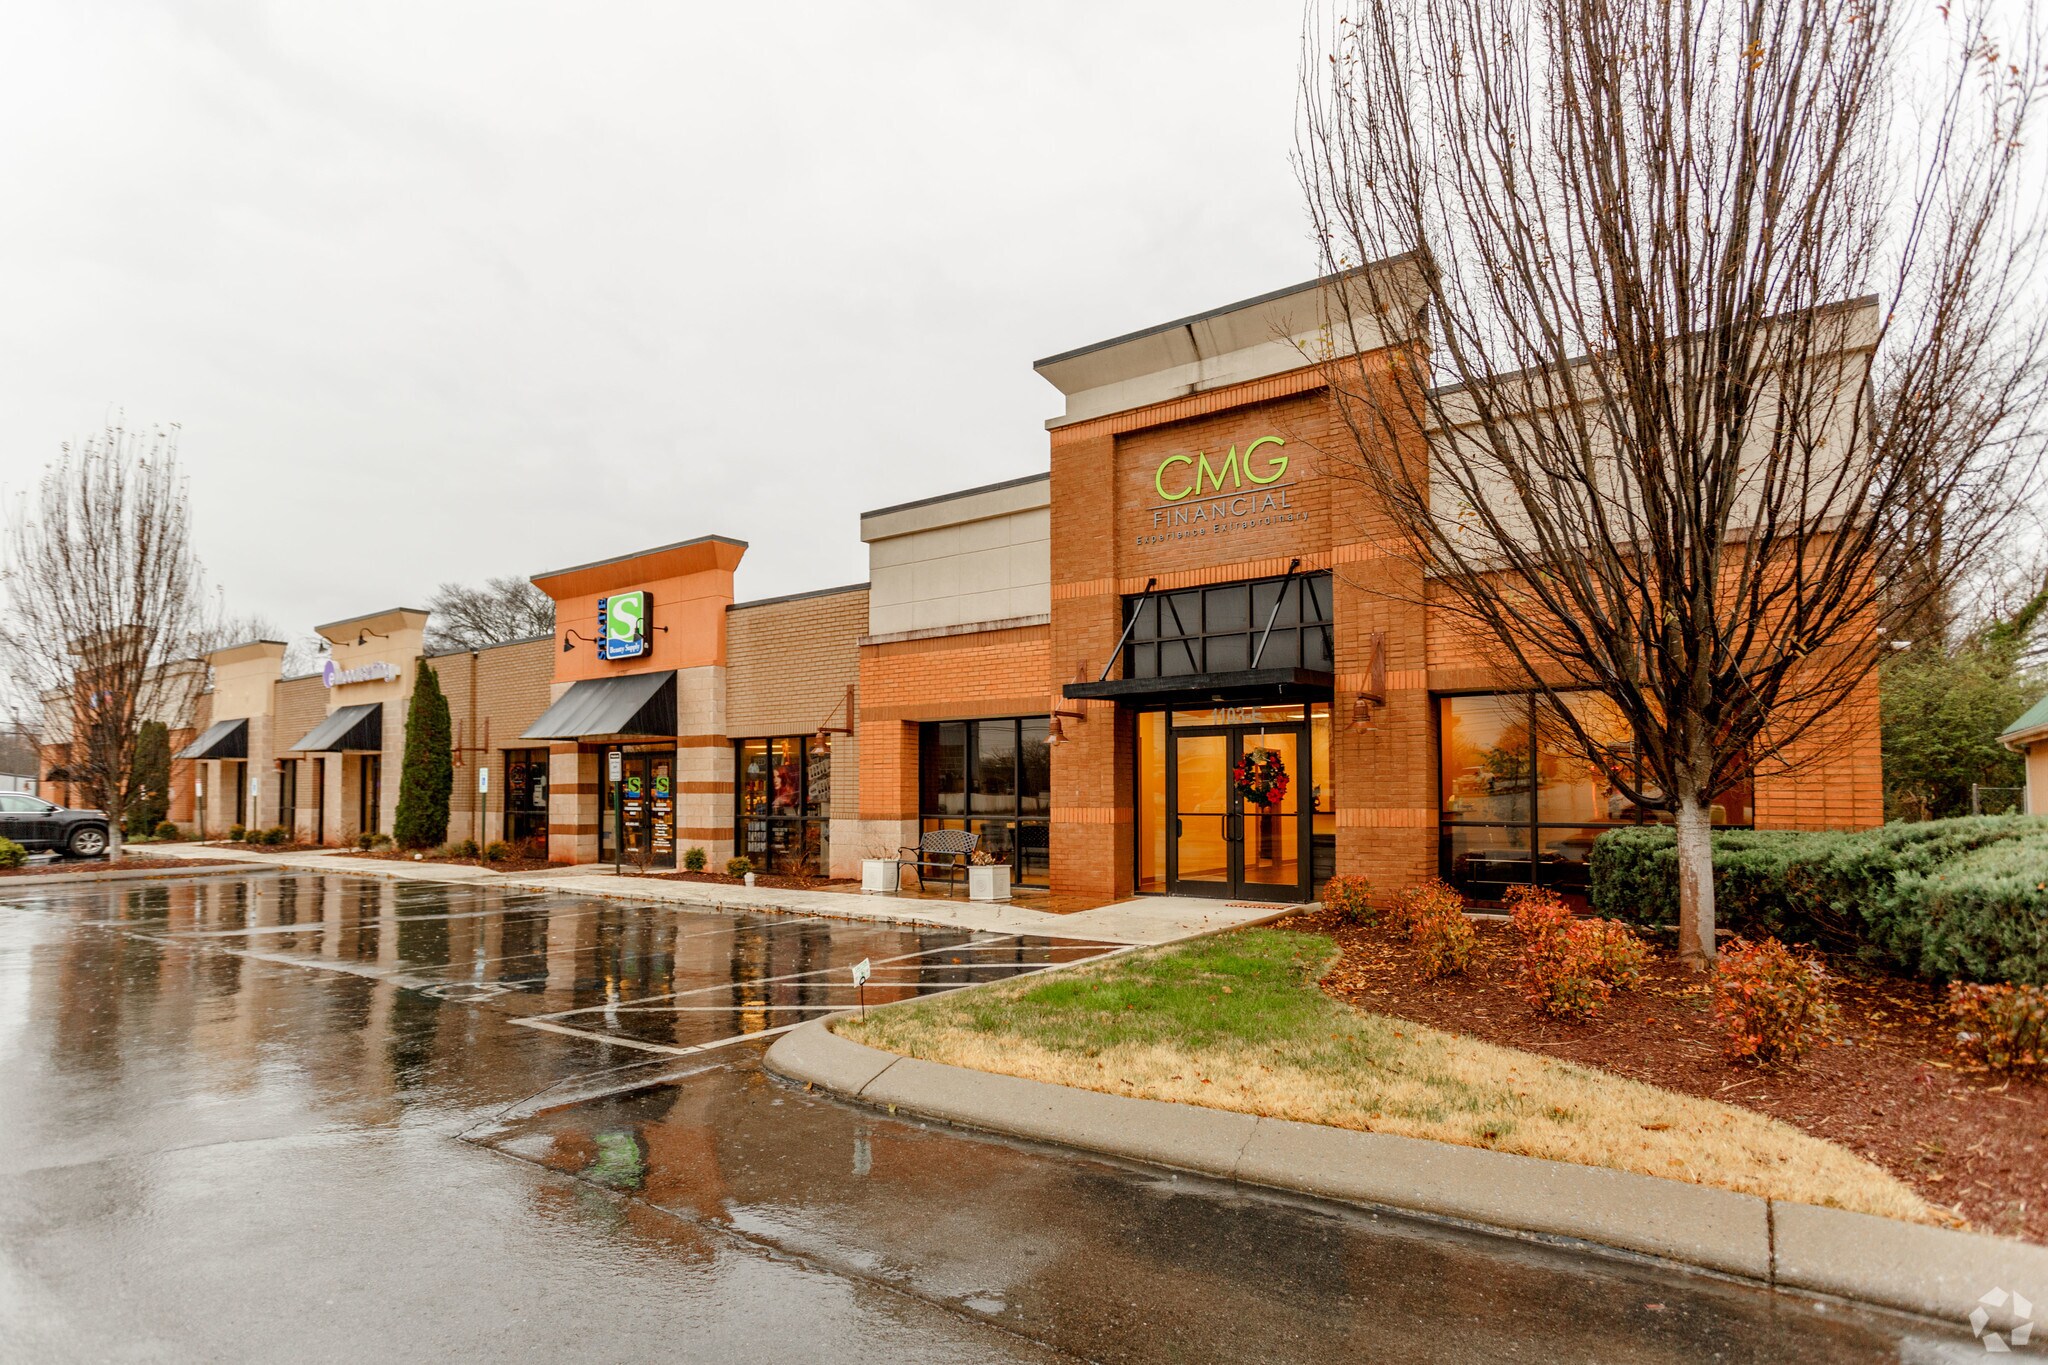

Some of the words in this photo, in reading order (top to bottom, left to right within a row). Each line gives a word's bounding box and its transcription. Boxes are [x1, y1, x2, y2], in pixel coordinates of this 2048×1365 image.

[1155, 435, 1289, 501] CMG
[1136, 527, 1206, 545] Experience
[1213, 511, 1309, 533] Extraordinary
[1153, 490, 1292, 529] FINANCIAL
[598, 599, 607, 660] STATE
[611, 598, 638, 638] S
[625, 643, 640, 652] Supply
[1212, 706, 1262, 725] 1103-E
